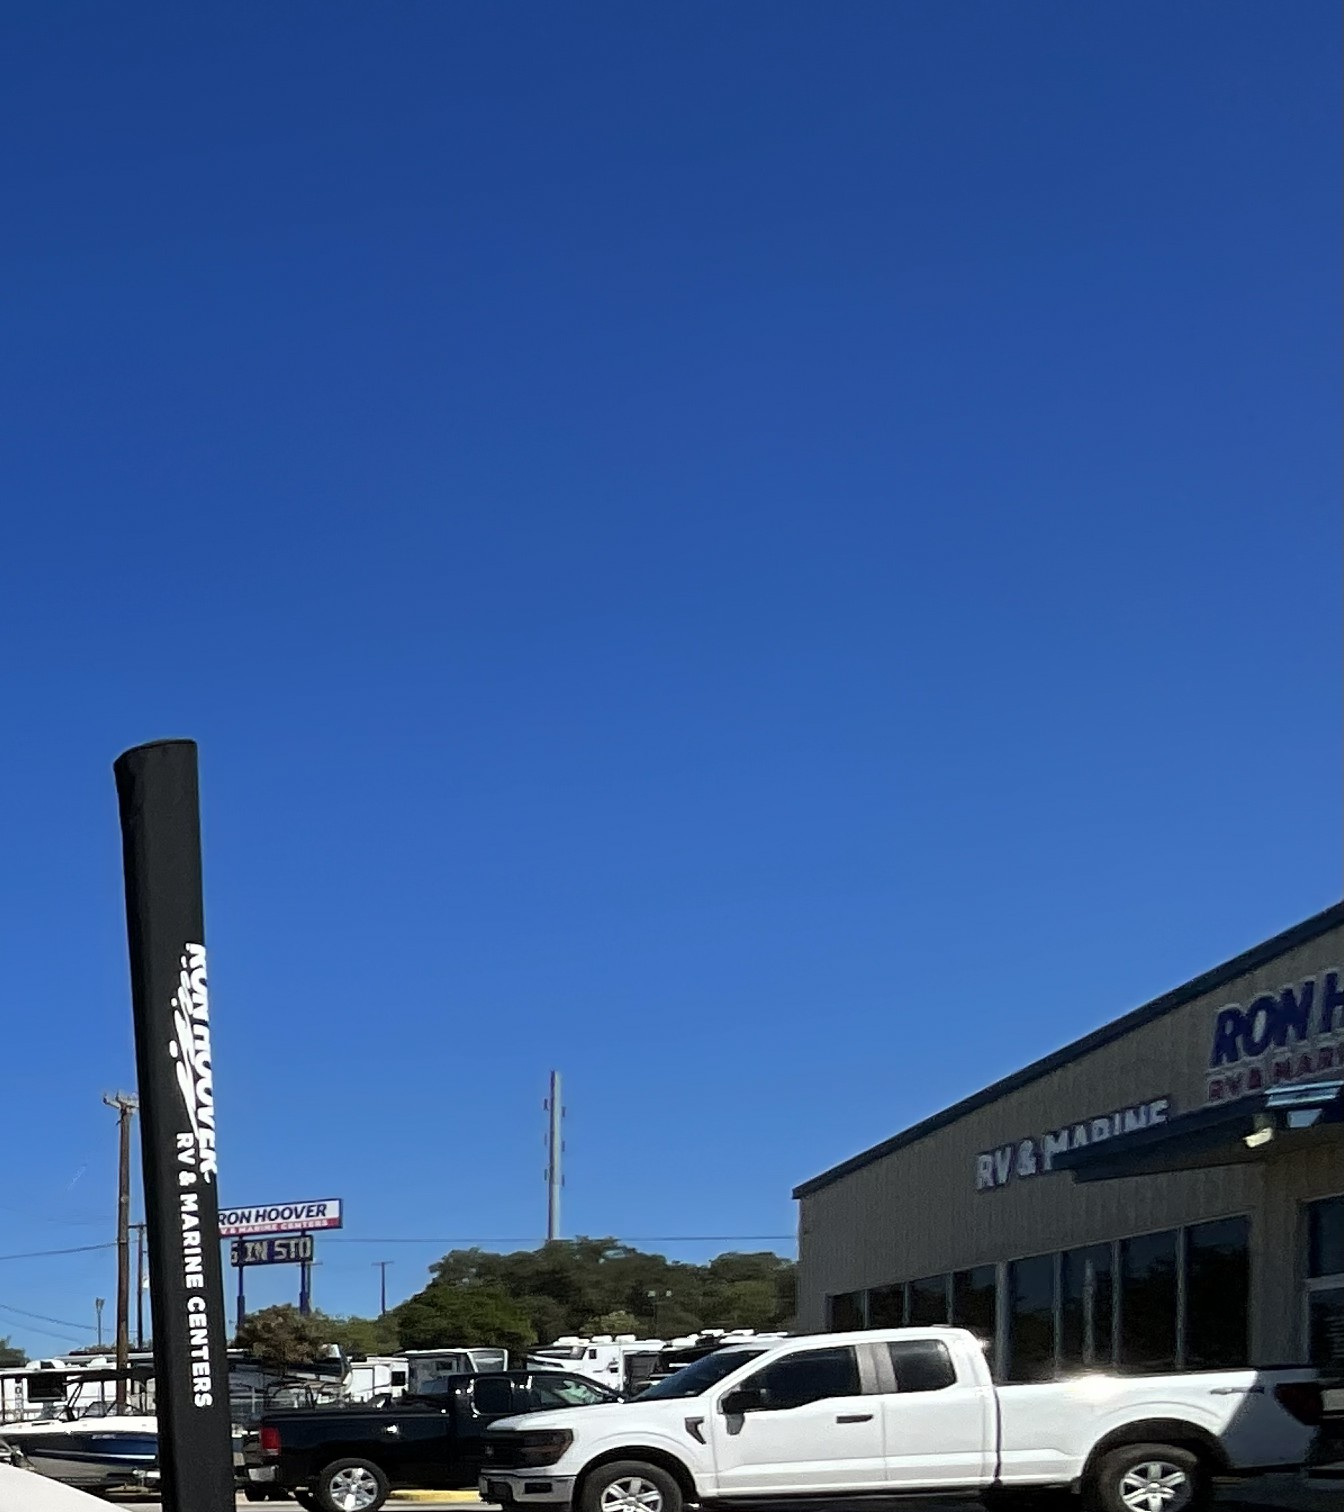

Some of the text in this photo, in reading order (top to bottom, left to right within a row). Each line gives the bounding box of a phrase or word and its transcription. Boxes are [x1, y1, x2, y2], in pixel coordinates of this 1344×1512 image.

[1209, 979, 1315, 1069] RON
[976, 1099, 1171, 1189] RV & MARINE
[218, 1203, 327, 1226] RON HOOVER
[238, 1223, 278, 1233] MARINE
[281, 1219, 329, 1230] CENTERS
[176, 1132, 214, 1408] RV & MARINE CENTERS
[244, 1241, 269, 1262] IN
